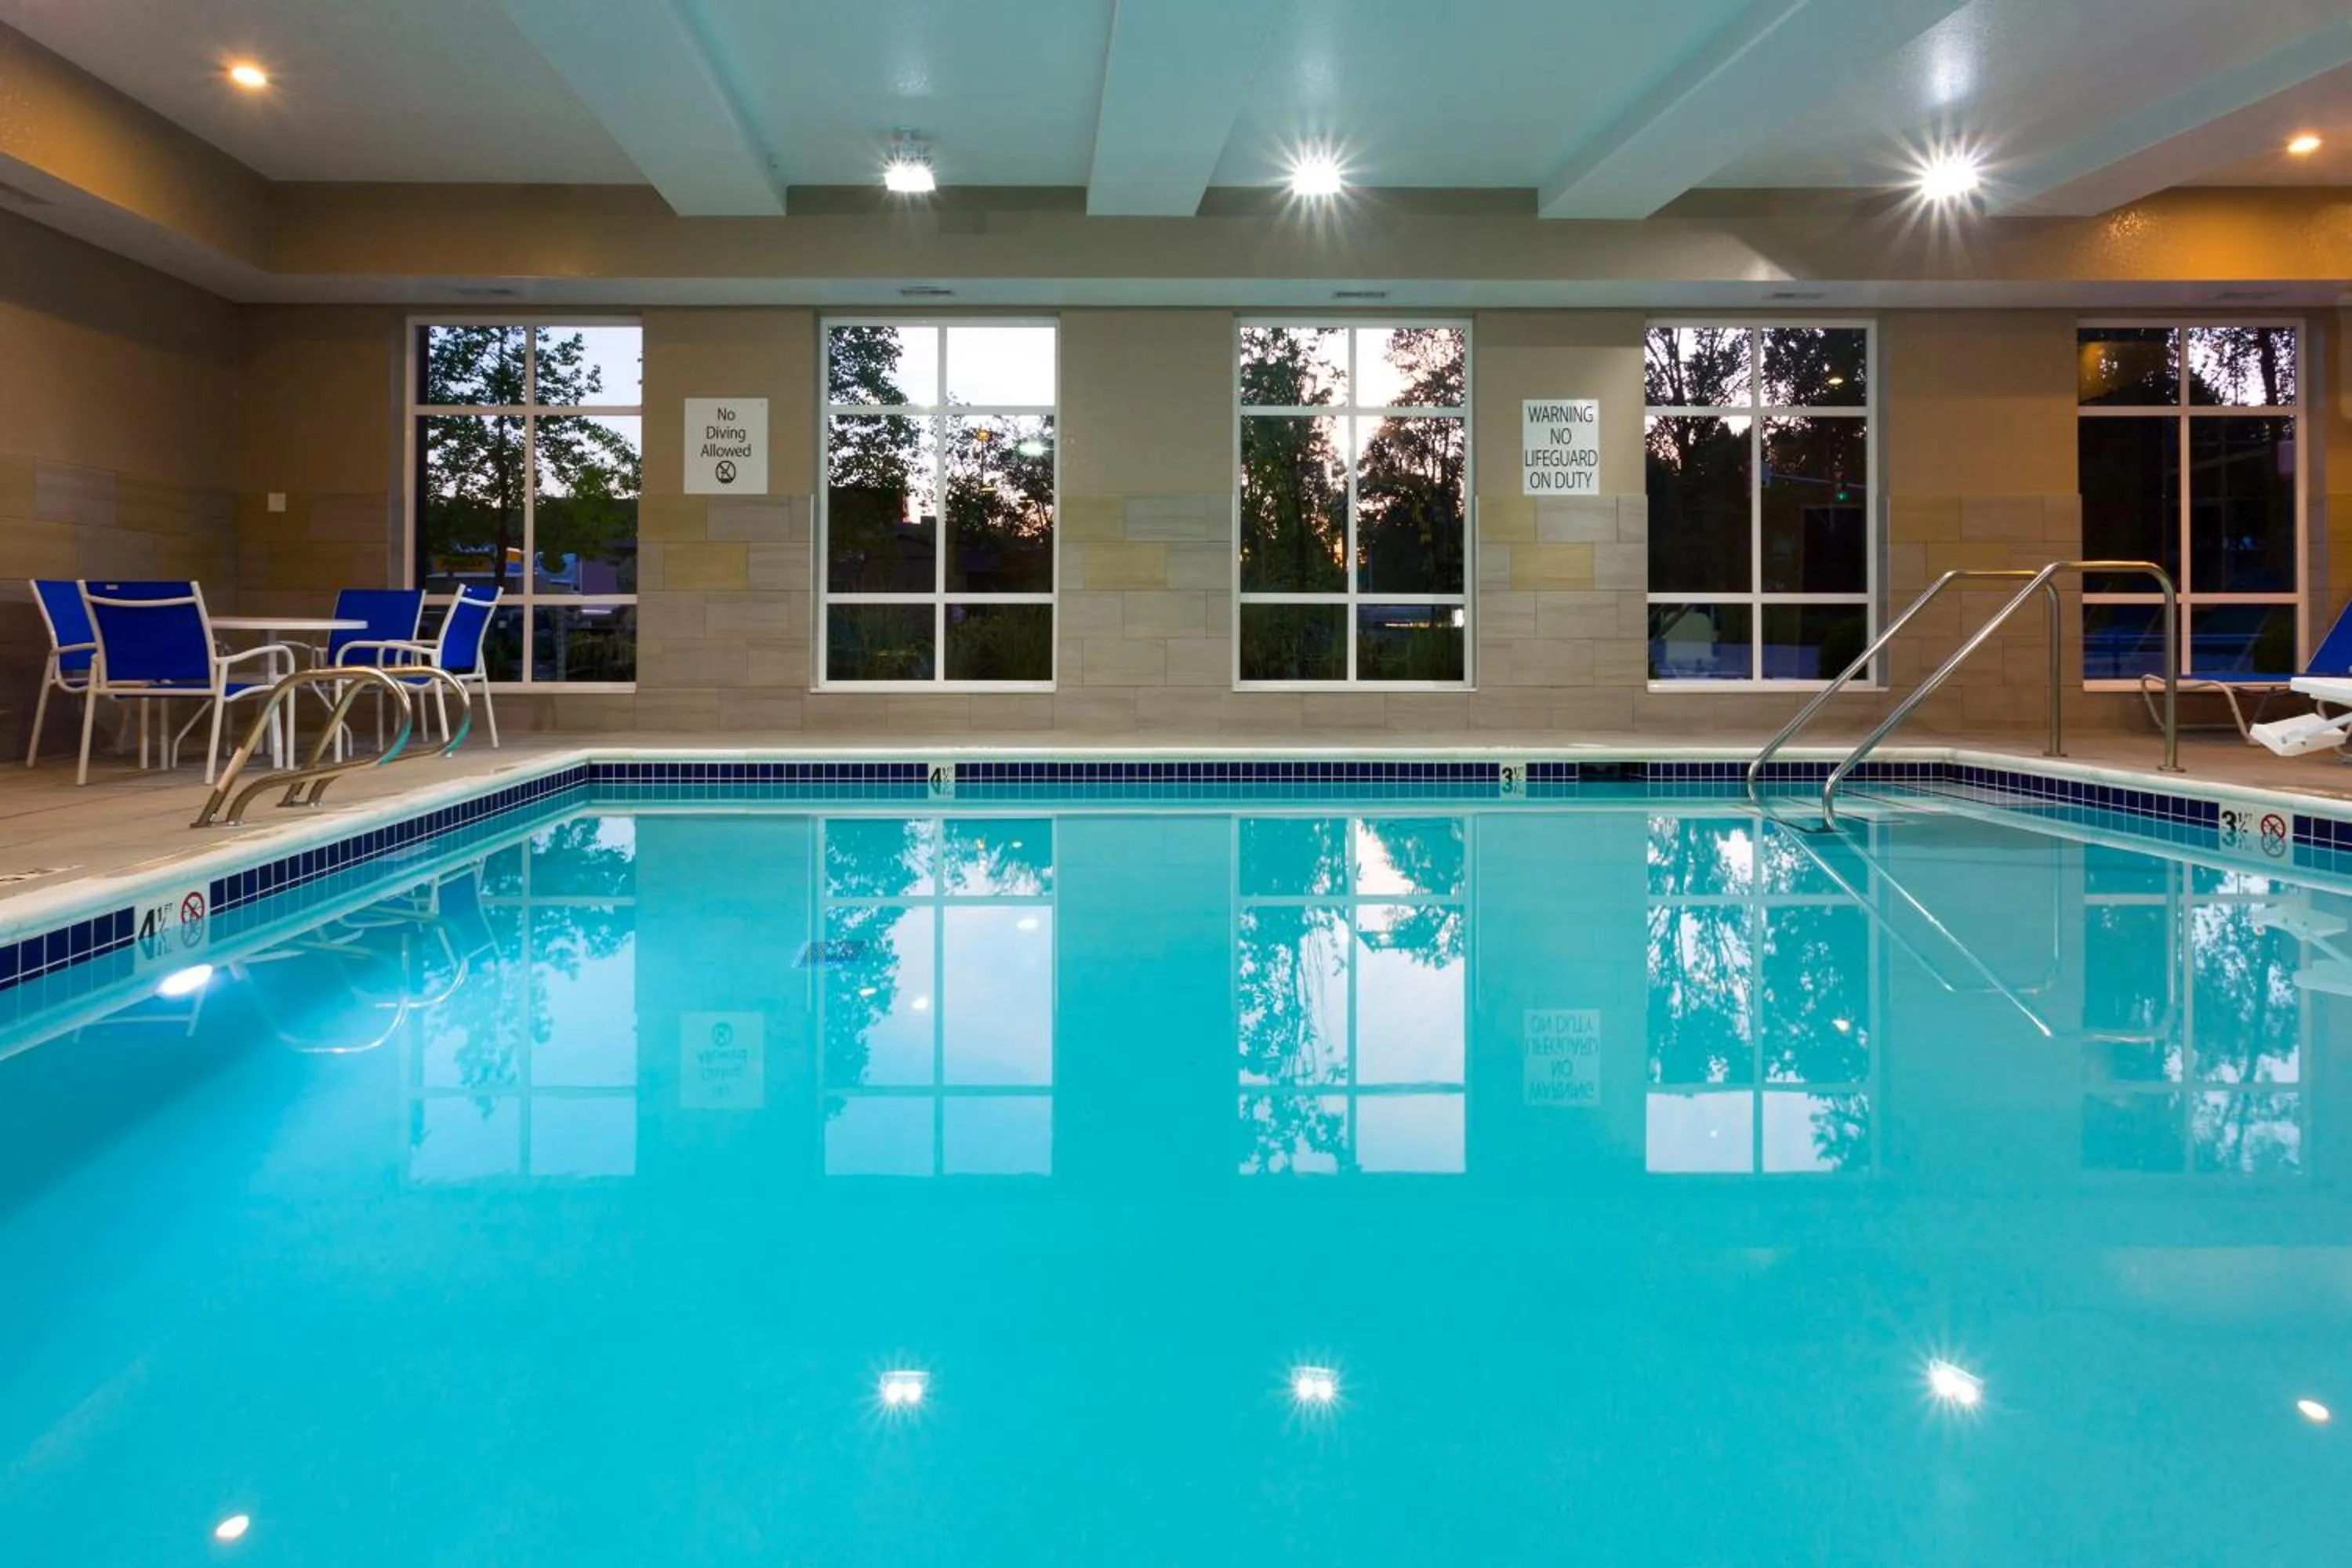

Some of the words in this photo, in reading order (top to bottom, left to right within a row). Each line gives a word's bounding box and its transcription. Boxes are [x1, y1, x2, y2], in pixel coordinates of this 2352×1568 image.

[717, 408, 735, 421] No
[1528, 406, 1594, 423] WARNING
[706, 426, 746, 442] Diving
[1550, 428, 1572, 445] NO
[700, 443, 751, 457] Allowed
[1525, 449, 1598, 466] LIFEGUARD
[1530, 472, 1551, 488] ON
[1555, 472, 1592, 488] DUTY
